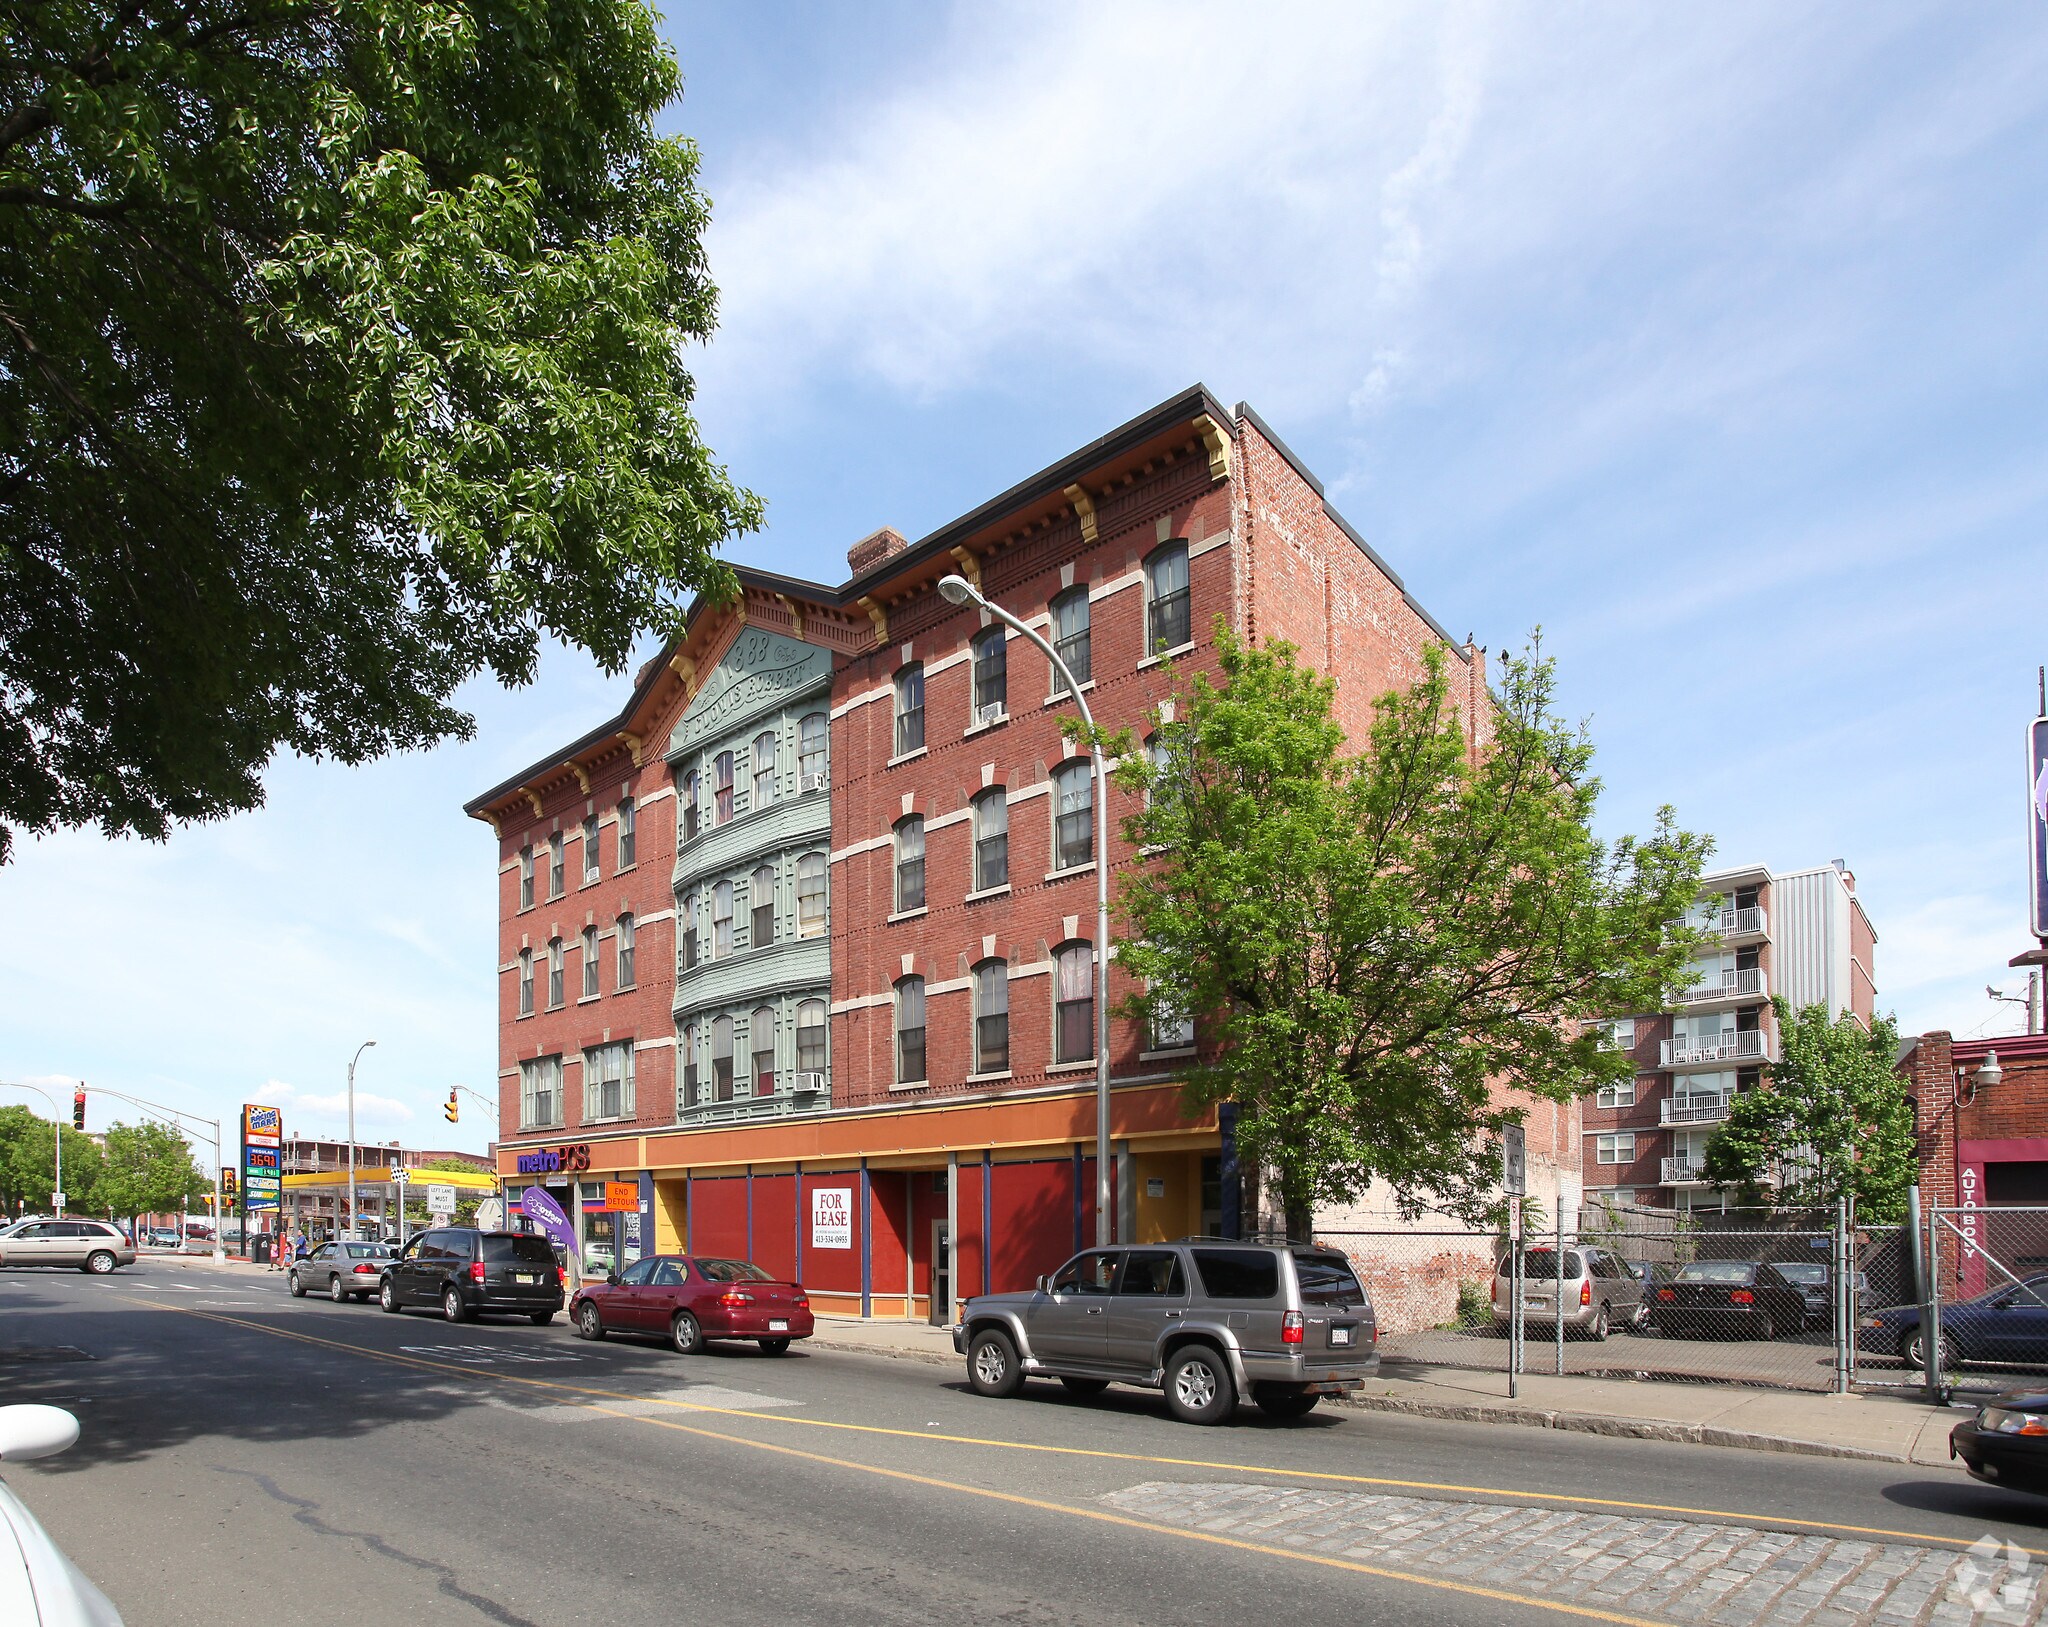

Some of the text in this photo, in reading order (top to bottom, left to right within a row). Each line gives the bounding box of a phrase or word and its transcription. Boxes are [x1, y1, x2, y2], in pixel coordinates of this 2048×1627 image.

[724, 634, 770, 680] 1888
[747, 664, 806, 697] ROBERT
[250, 1110, 276, 1123] RACING
[518, 1144, 590, 1172] metroPCS
[248, 1190, 278, 1199] SUBWAY
[614, 1187, 629, 1195] END
[607, 1197, 635, 1206] DETOUR
[820, 1193, 842, 1209] FOR
[815, 1210, 848, 1227] LEASE
[815, 1235, 848, 1244] 413-534-0955
